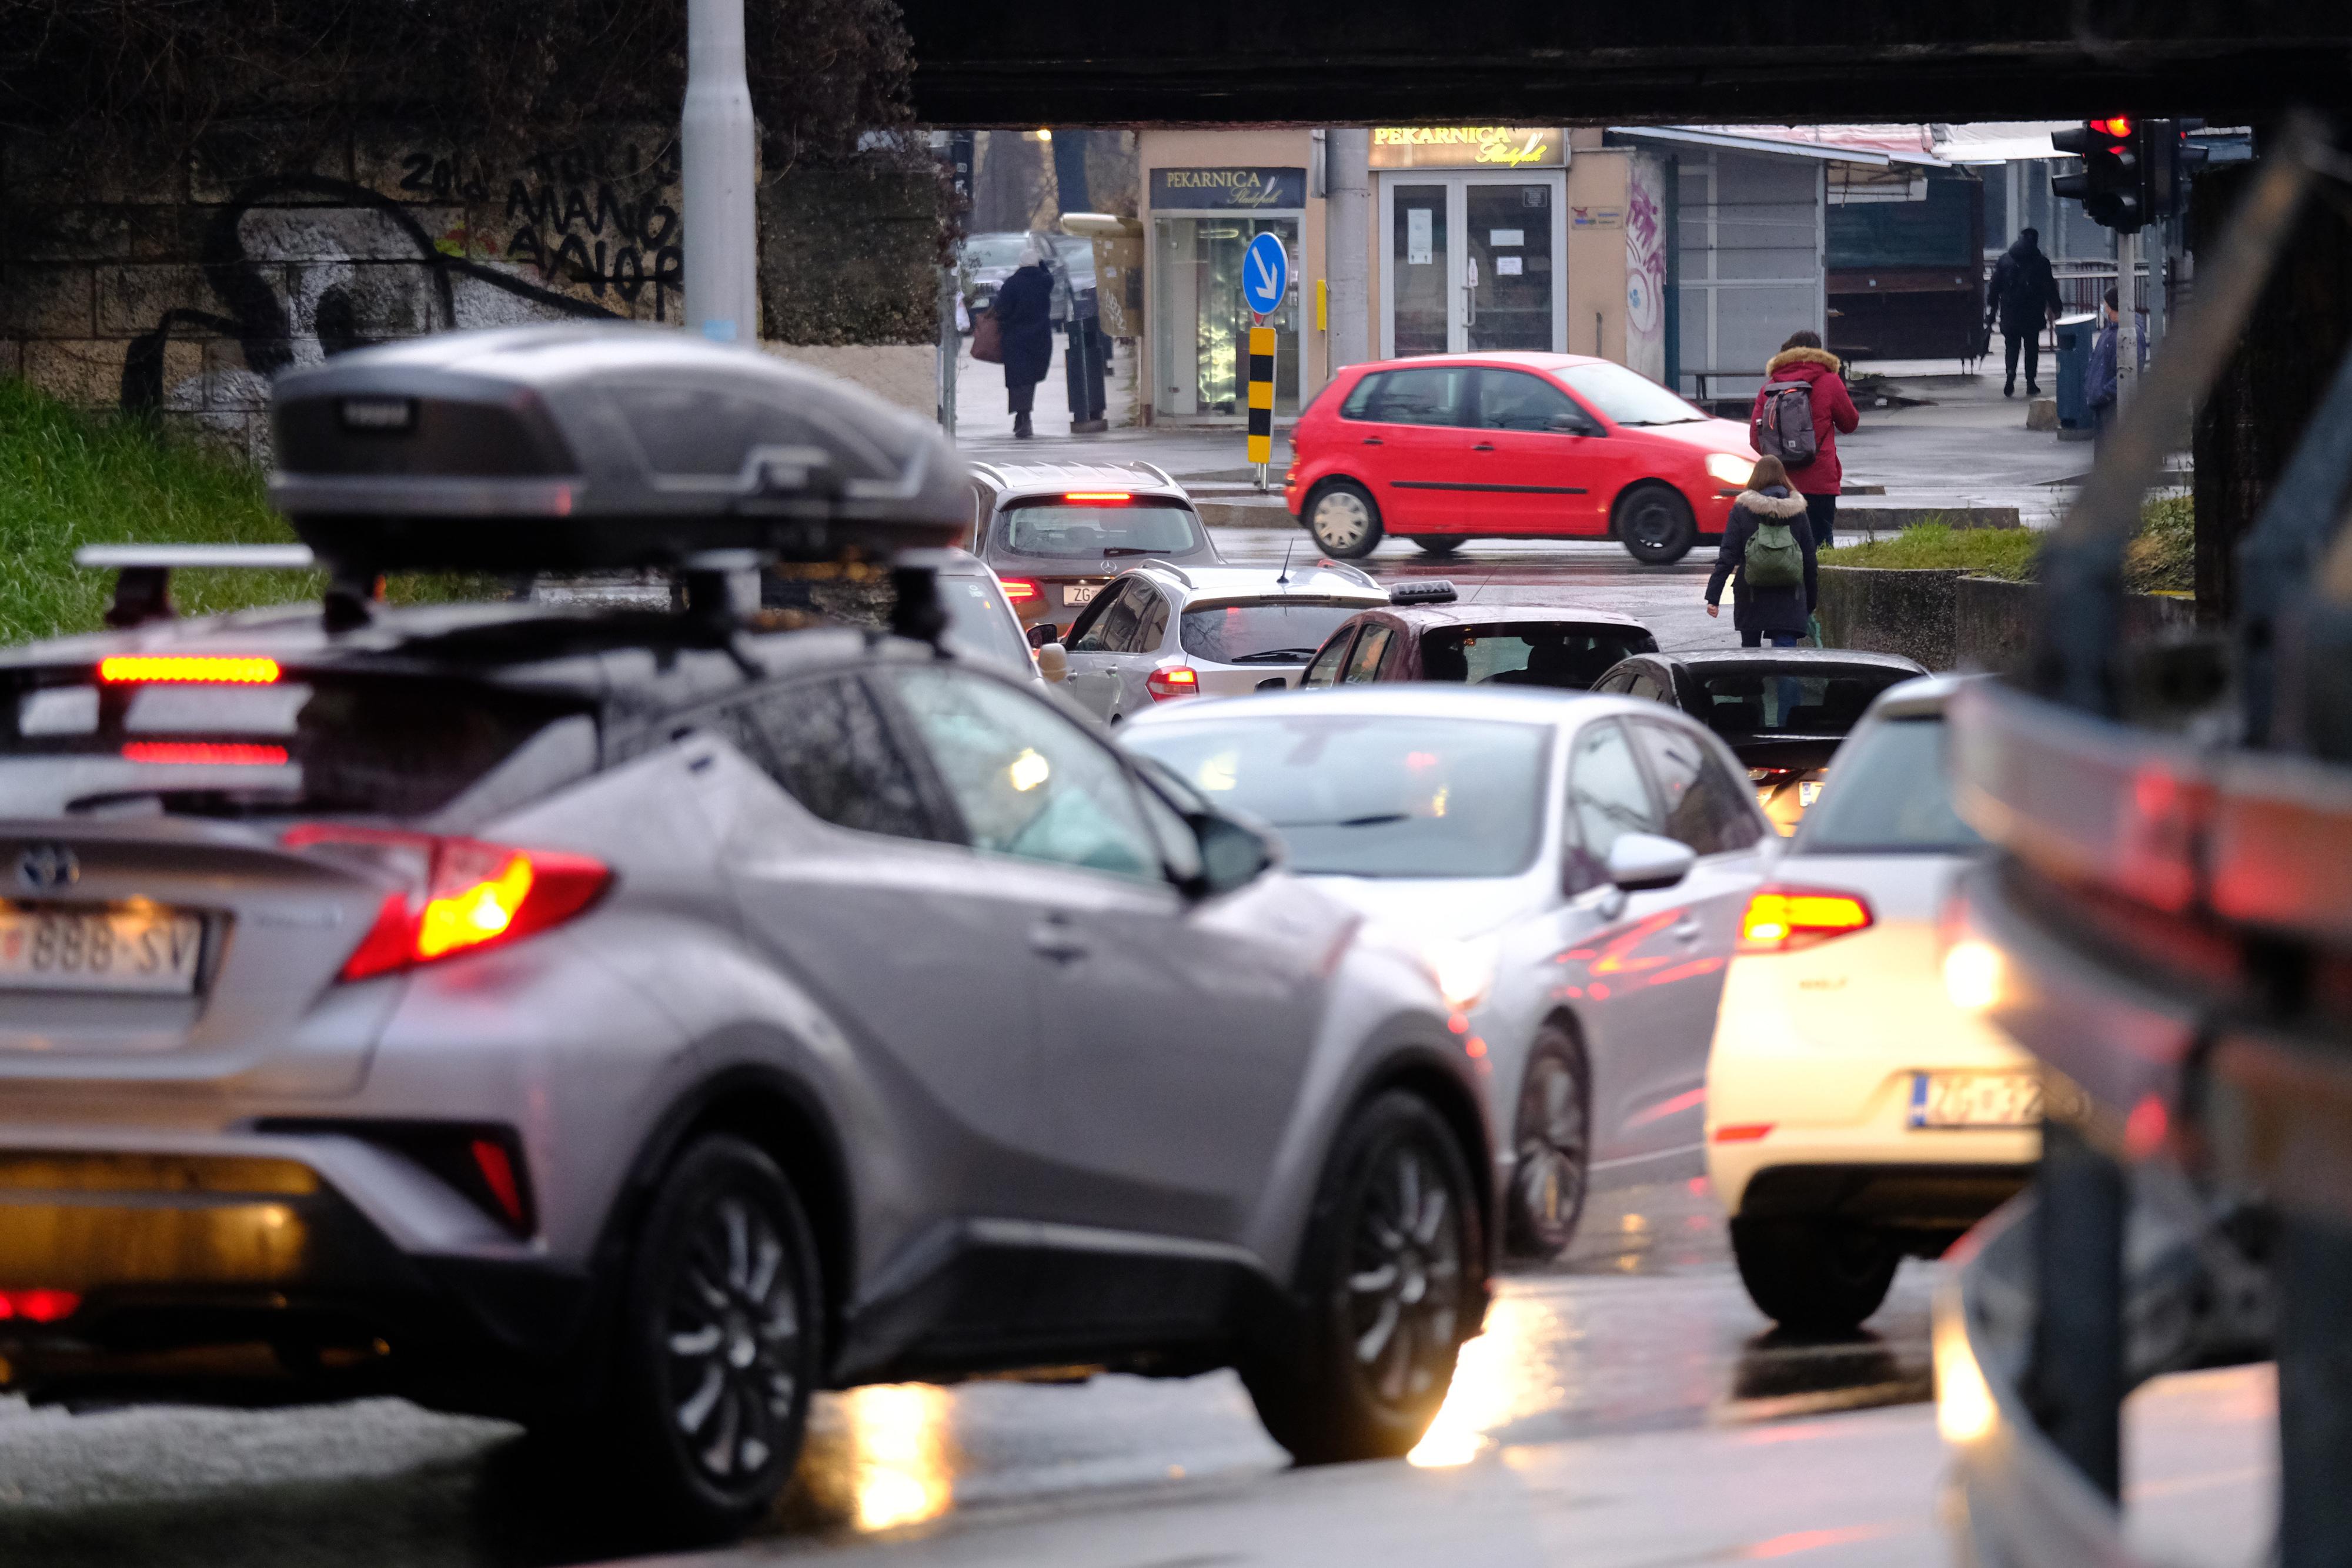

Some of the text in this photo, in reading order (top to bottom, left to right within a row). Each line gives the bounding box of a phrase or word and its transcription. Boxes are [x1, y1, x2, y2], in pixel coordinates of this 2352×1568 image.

[1374, 126, 1512, 145] PEKARNICA
[1167, 170, 1262, 188] PEKARNICA
[1074, 588, 1090, 601] ZG
[1399, 581, 1449, 594] TAXI
